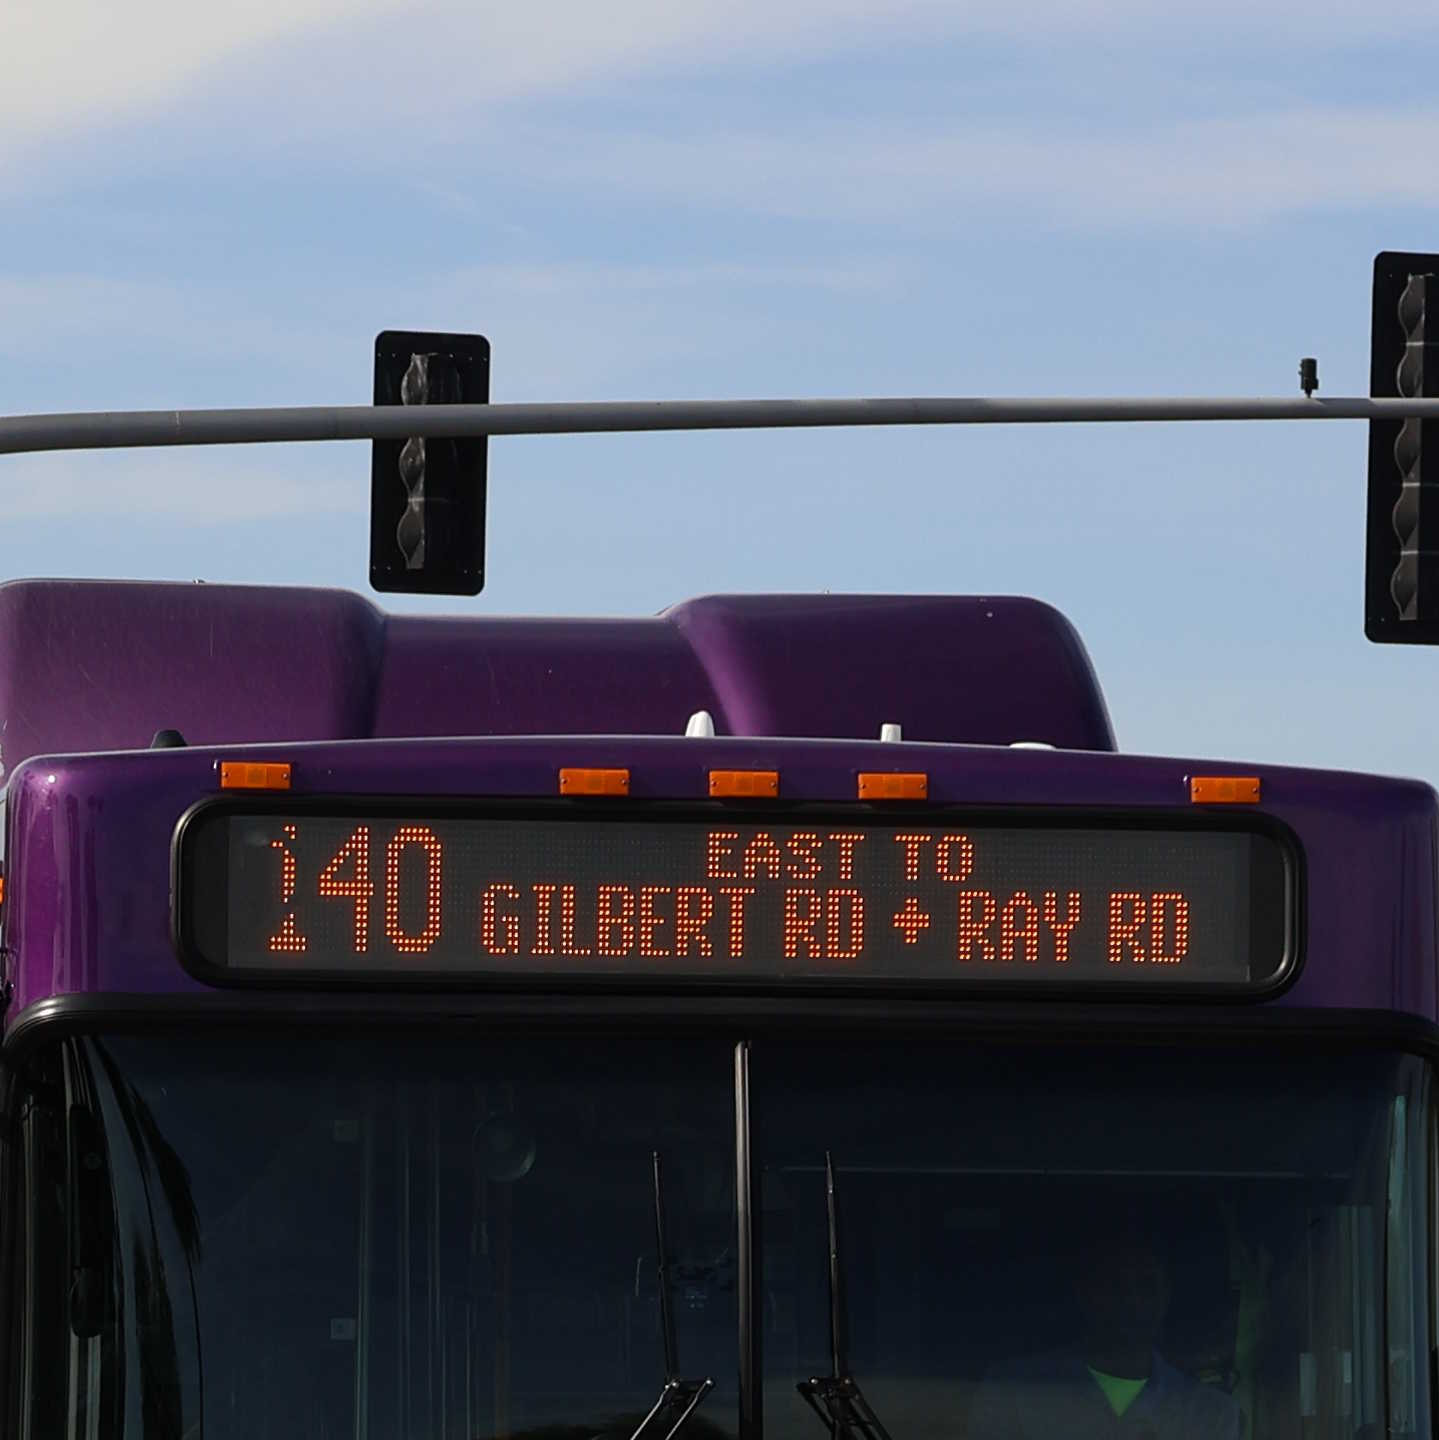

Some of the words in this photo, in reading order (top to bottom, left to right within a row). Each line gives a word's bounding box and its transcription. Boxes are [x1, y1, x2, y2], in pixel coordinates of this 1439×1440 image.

[269, 824, 442, 953] 140
[706, 832, 865, 880] EAST
[894, 834, 974, 882] TO
[480, 884, 757, 957] GILBERT
[783, 888, 864, 959] RD
[959, 890, 1081, 962] RAY
[1108, 892, 1191, 963] RD
